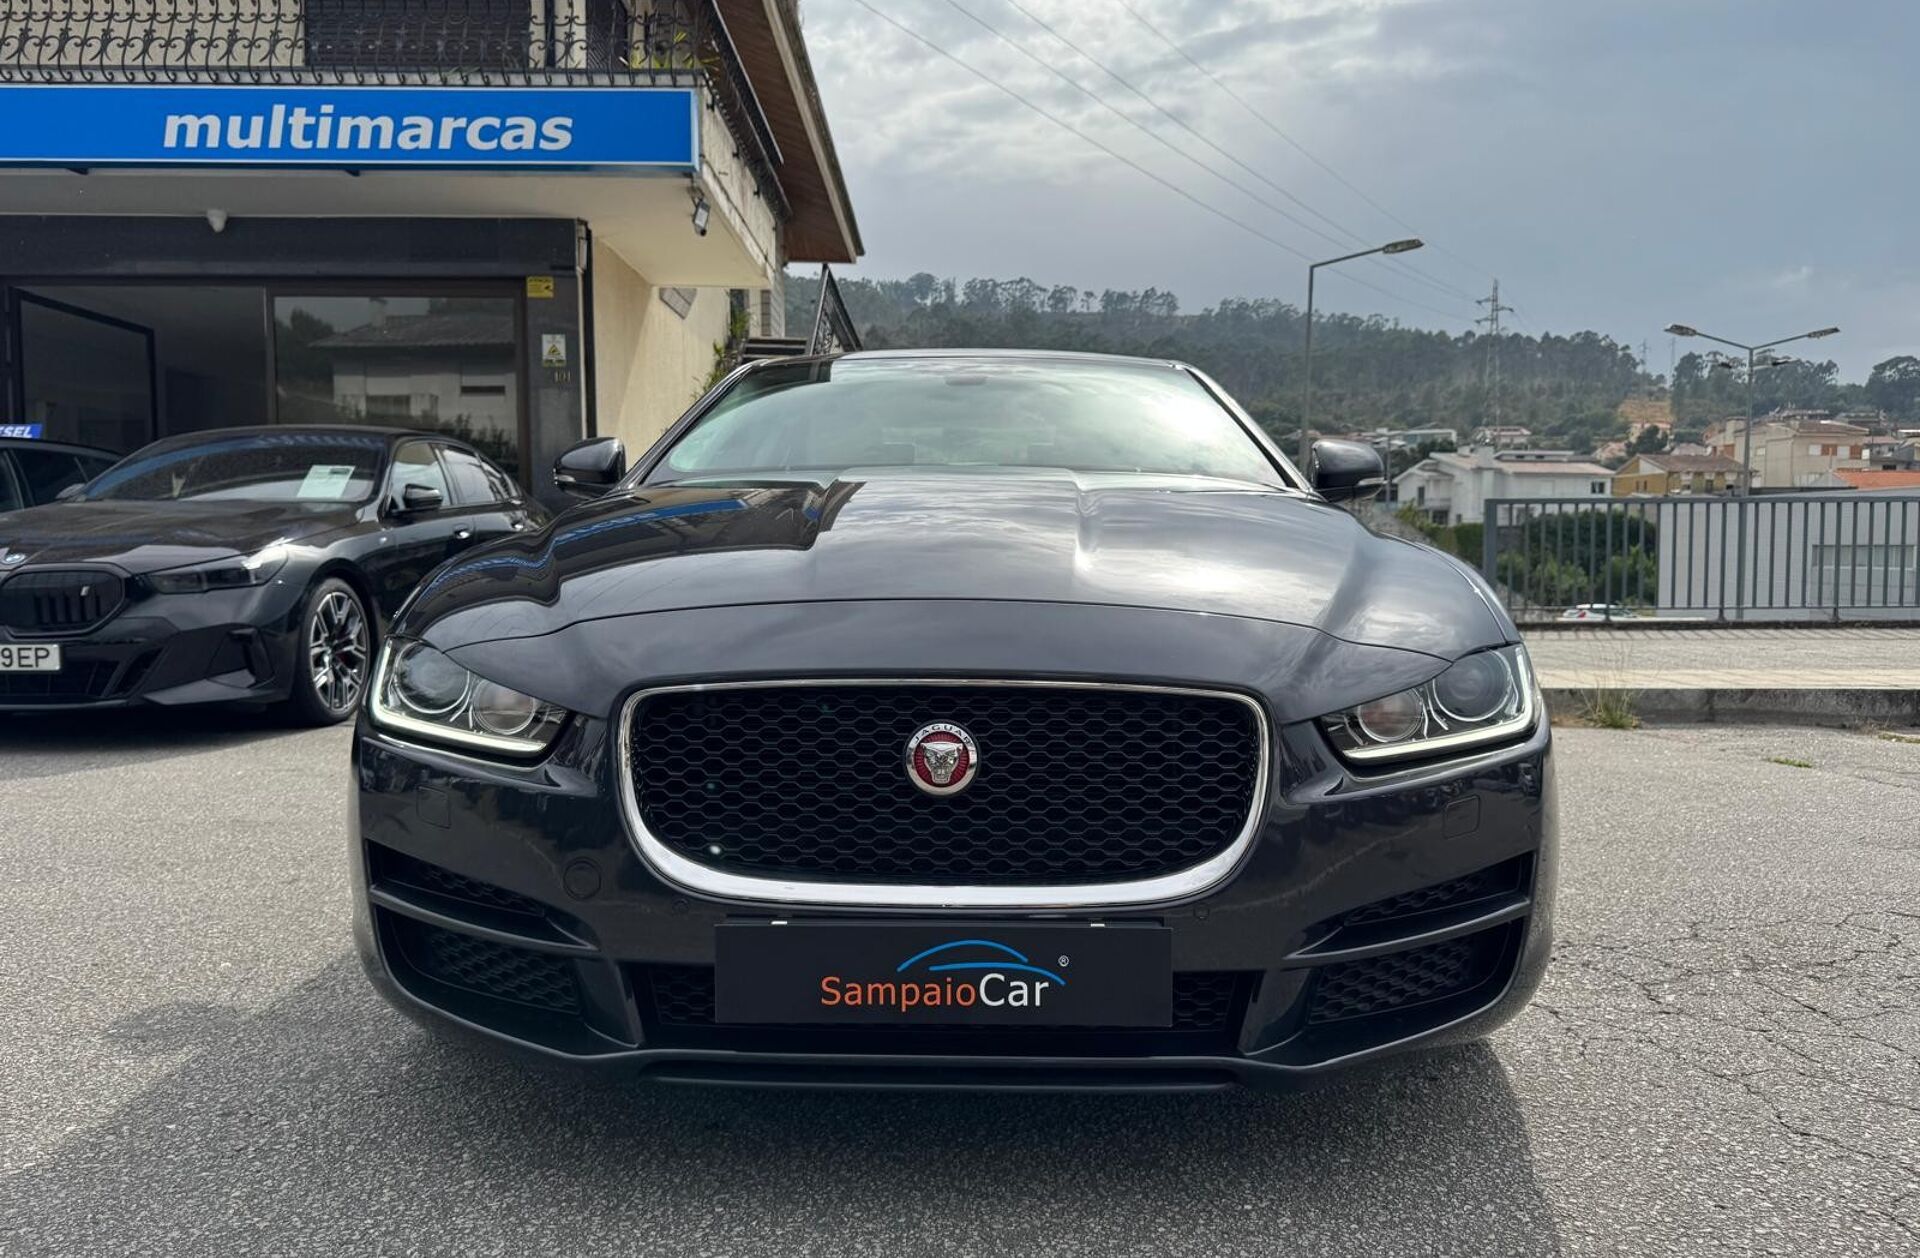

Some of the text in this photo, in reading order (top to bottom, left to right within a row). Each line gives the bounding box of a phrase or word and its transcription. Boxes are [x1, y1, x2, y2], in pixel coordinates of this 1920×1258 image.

[163, 104, 573, 151] multimarcas
[915, 725, 973, 746] JAGUAR
[820, 973, 1050, 1013] SampaioCar
